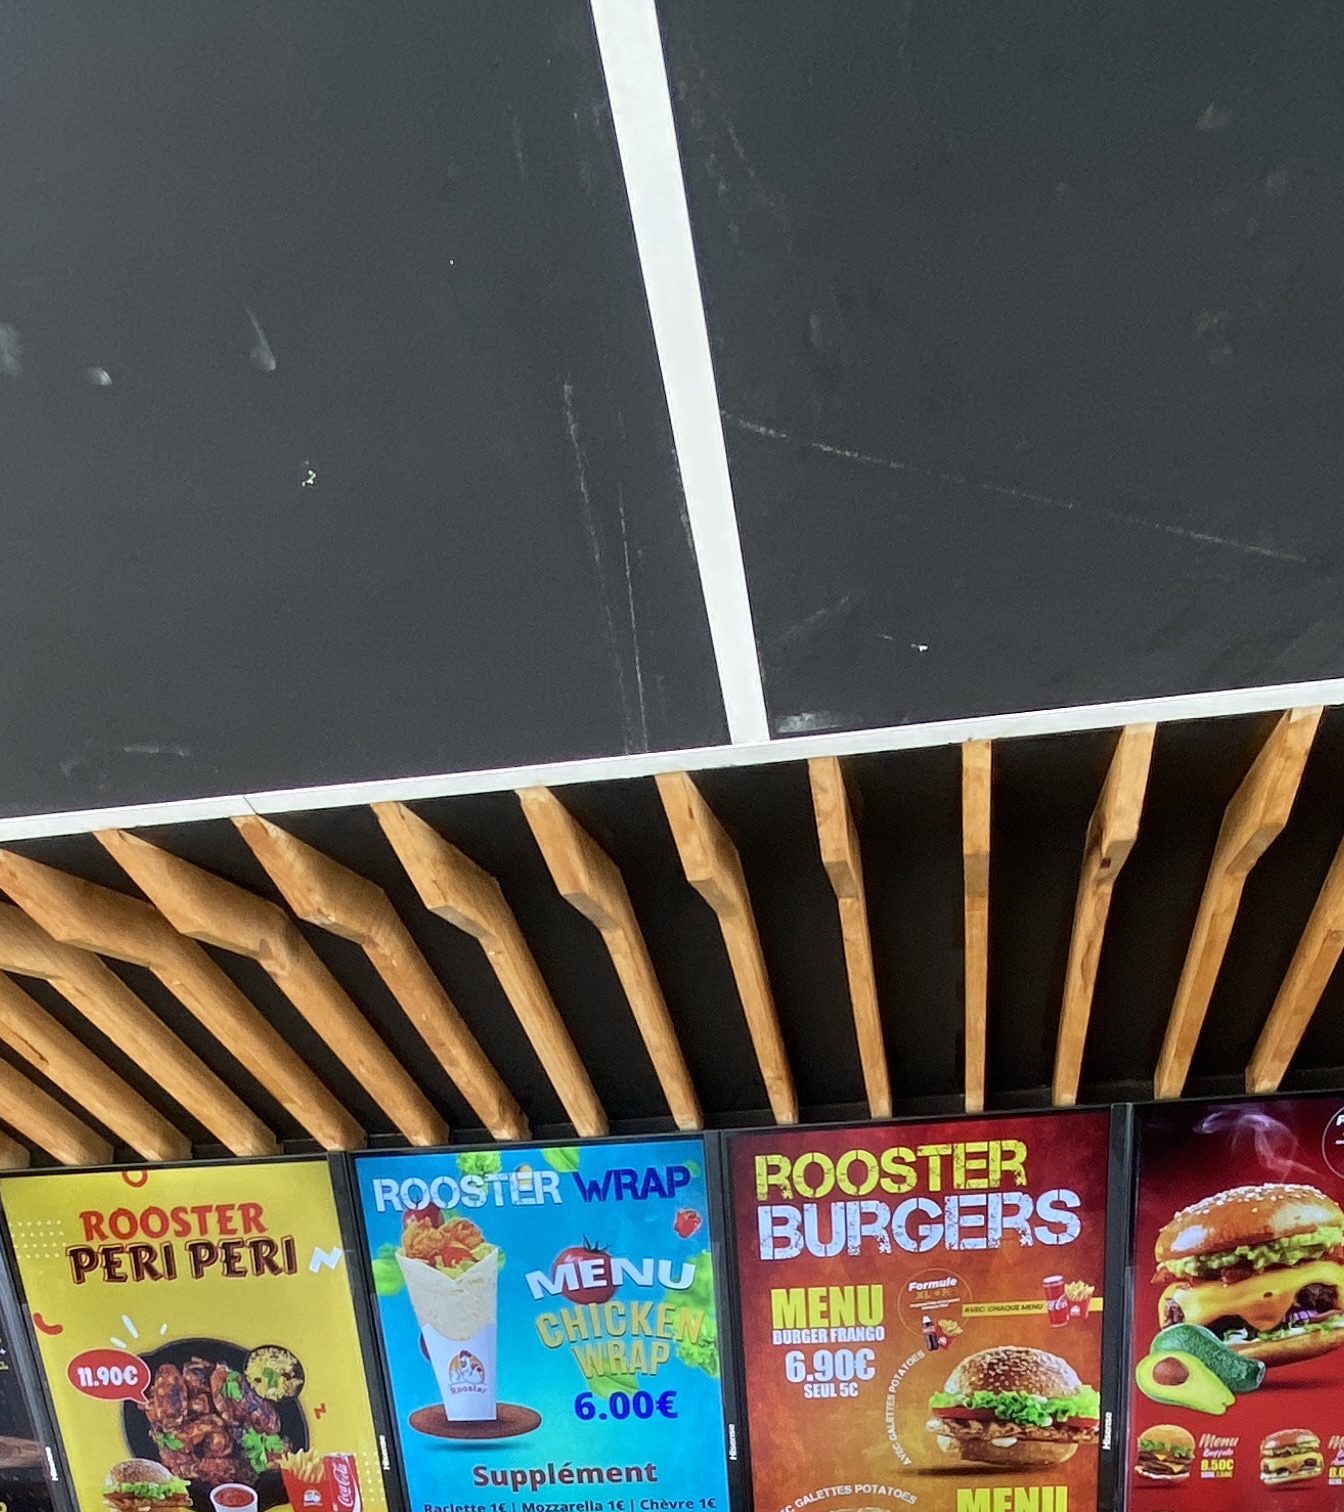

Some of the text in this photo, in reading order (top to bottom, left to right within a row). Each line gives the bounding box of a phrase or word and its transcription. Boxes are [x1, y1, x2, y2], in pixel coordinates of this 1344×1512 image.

[754, 1139, 1027, 1201] ROOSTER
[372, 1165, 691, 1213] ROOSTER WRAP
[79, 1202, 269, 1241] ROOSTER
[757, 1188, 1081, 1260] BURGERS
[66, 1235, 297, 1284] PERI PERI
[525, 1256, 696, 1300] MENU
[908, 1277, 957, 1291] Formule
[536, 1301, 705, 1350] CHICKEN
[770, 1284, 884, 1330] MENU
[772, 1325, 885, 1345] BURGER FRANGO
[77, 1365, 138, 1387] 11.90€
[571, 1339, 671, 1380] WRAP
[784, 1348, 876, 1383] 6.90€
[889, 1350, 925, 1393] POTATOES
[574, 1390, 678, 1421] 6.00€
[803, 1382, 859, 1399] SEUL 5€
[1199, 1433, 1239, 1448] Menu
[472, 1461, 658, 1493] Supplément
[521, 1500, 603, 1512] Mozzarella
[607, 1499, 625, 1512] 1€
[640, 1498, 694, 1512] Chèvre
[698, 1498, 716, 1509] 1€
[795, 1485, 852, 1508] GALETTES
[855, 1484, 917, 1505] POTATOES
